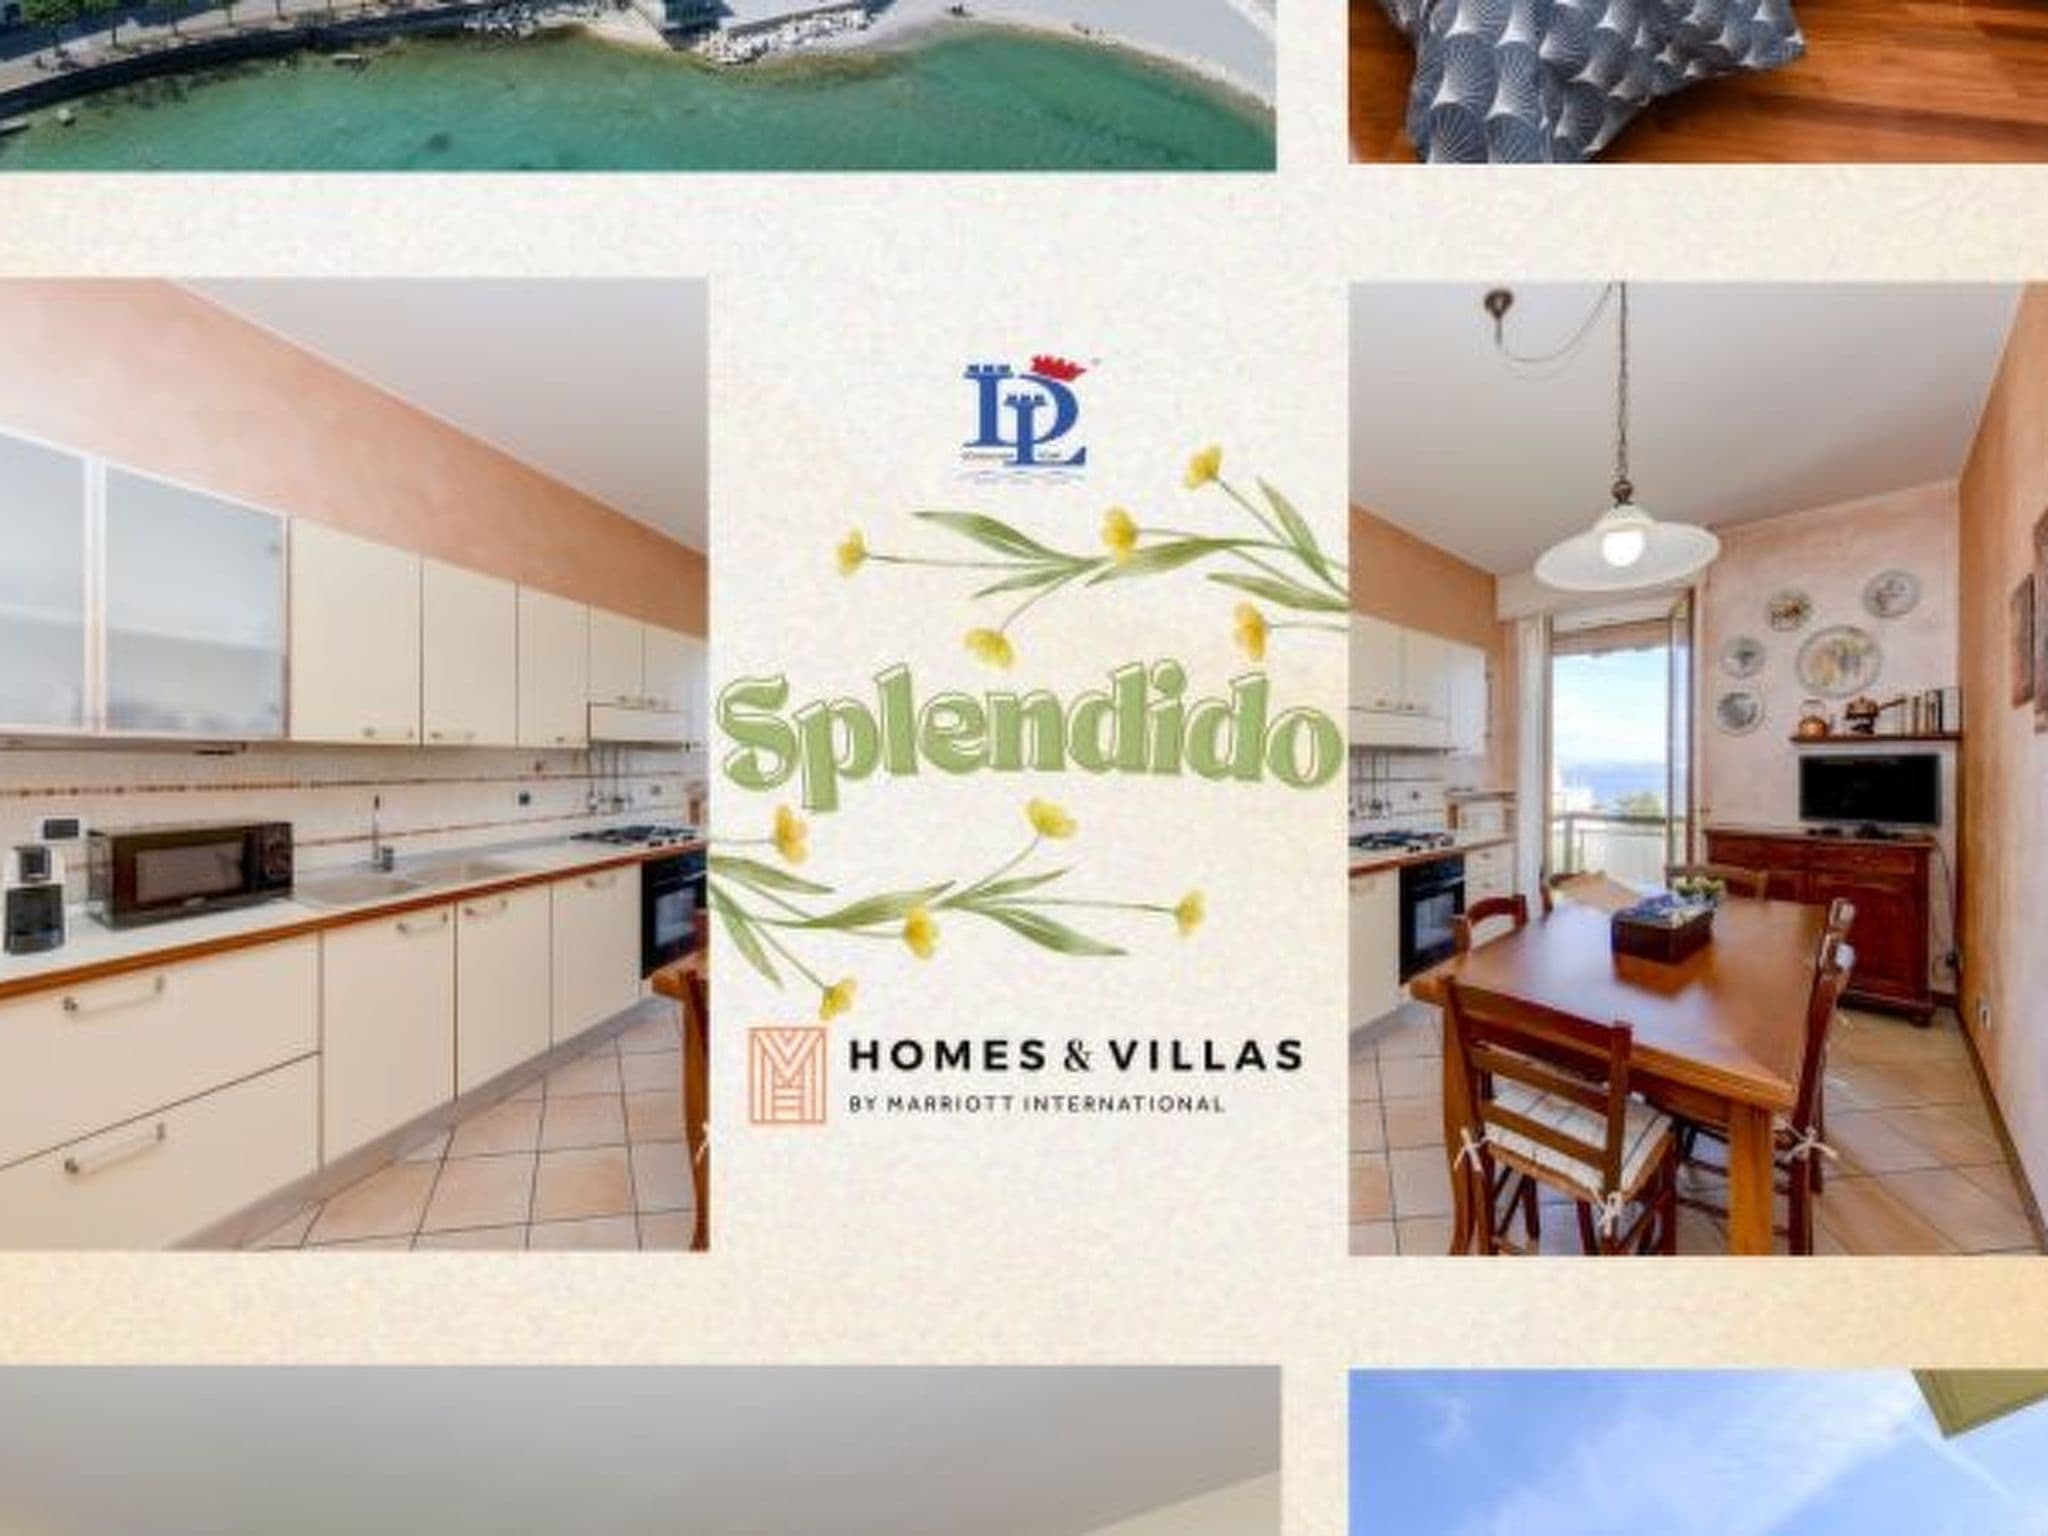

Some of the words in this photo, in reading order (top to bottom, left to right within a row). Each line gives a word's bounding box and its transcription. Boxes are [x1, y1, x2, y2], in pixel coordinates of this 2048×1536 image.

[716, 658, 1342, 812] Splendido
[849, 1039, 1046, 1072] HOMES
[1063, 1039, 1091, 1073] &
[1107, 1039, 1303, 1073] VILLAS
[849, 1095, 877, 1113] BY
[887, 1095, 1014, 1113] MARRIOTT
[1023, 1095, 1226, 1113] INTERNATIONAL
